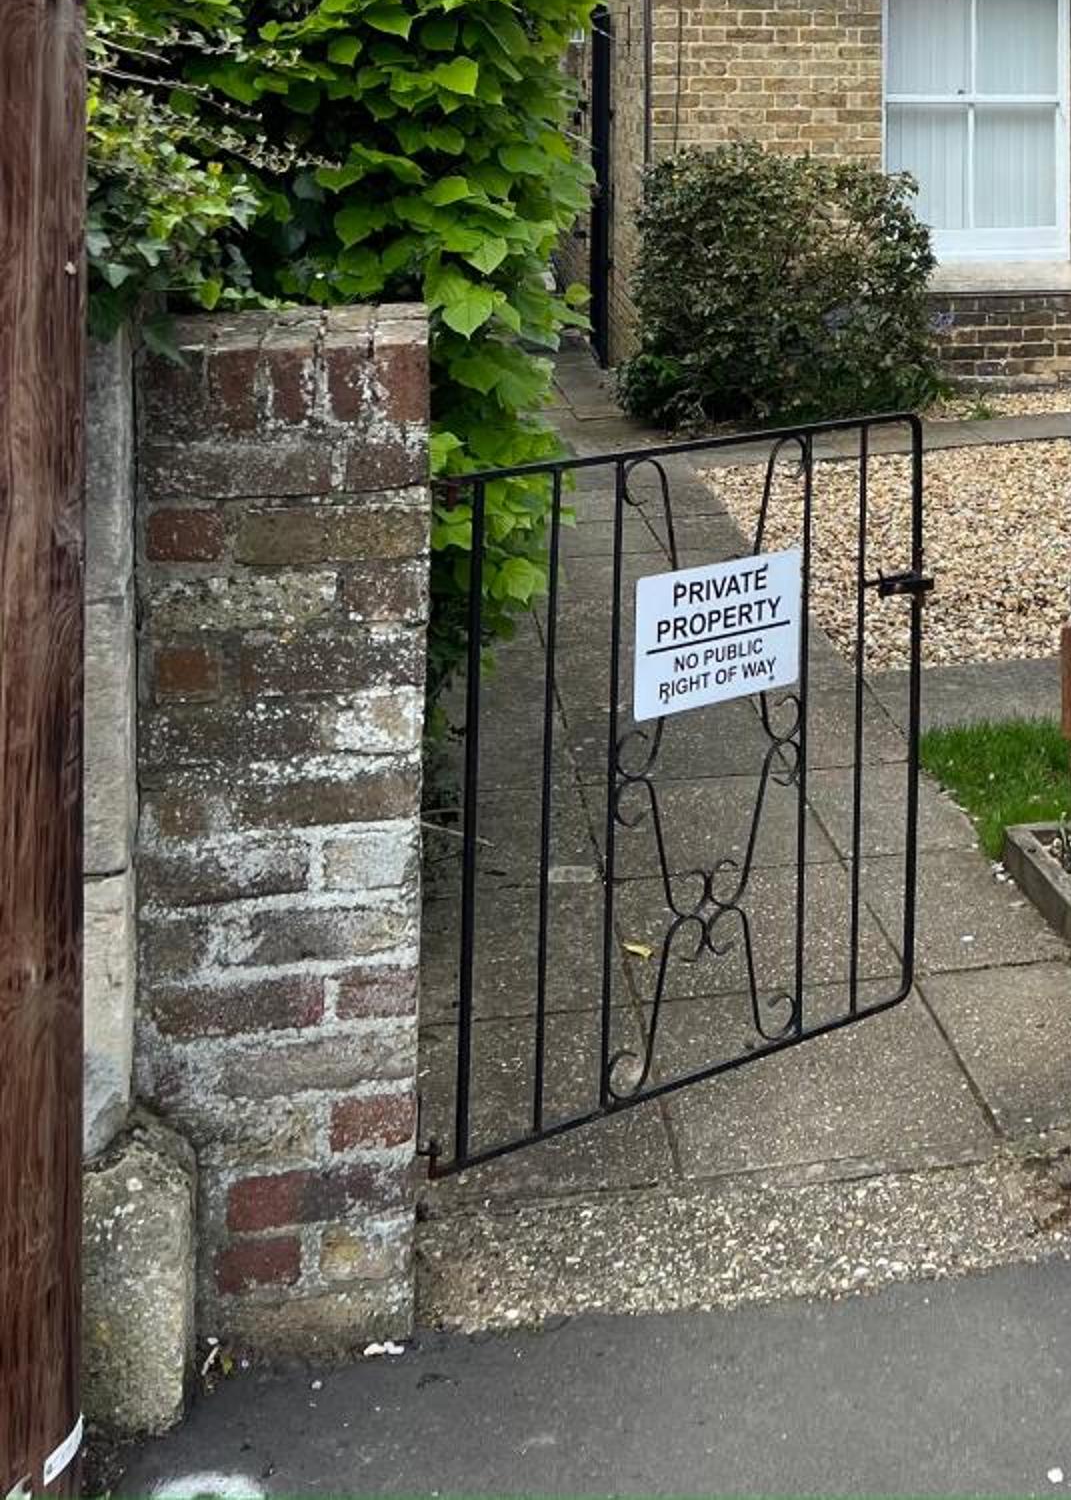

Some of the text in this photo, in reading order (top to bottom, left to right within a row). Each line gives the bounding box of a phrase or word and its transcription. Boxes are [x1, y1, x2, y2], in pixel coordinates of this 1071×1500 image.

[673, 566, 768, 607] PRIVATE
[657, 596, 781, 643] PROPERTY
[674, 638, 763, 672] NO PUBLIC
[659, 657, 776, 700] RIGHT OF WAY
